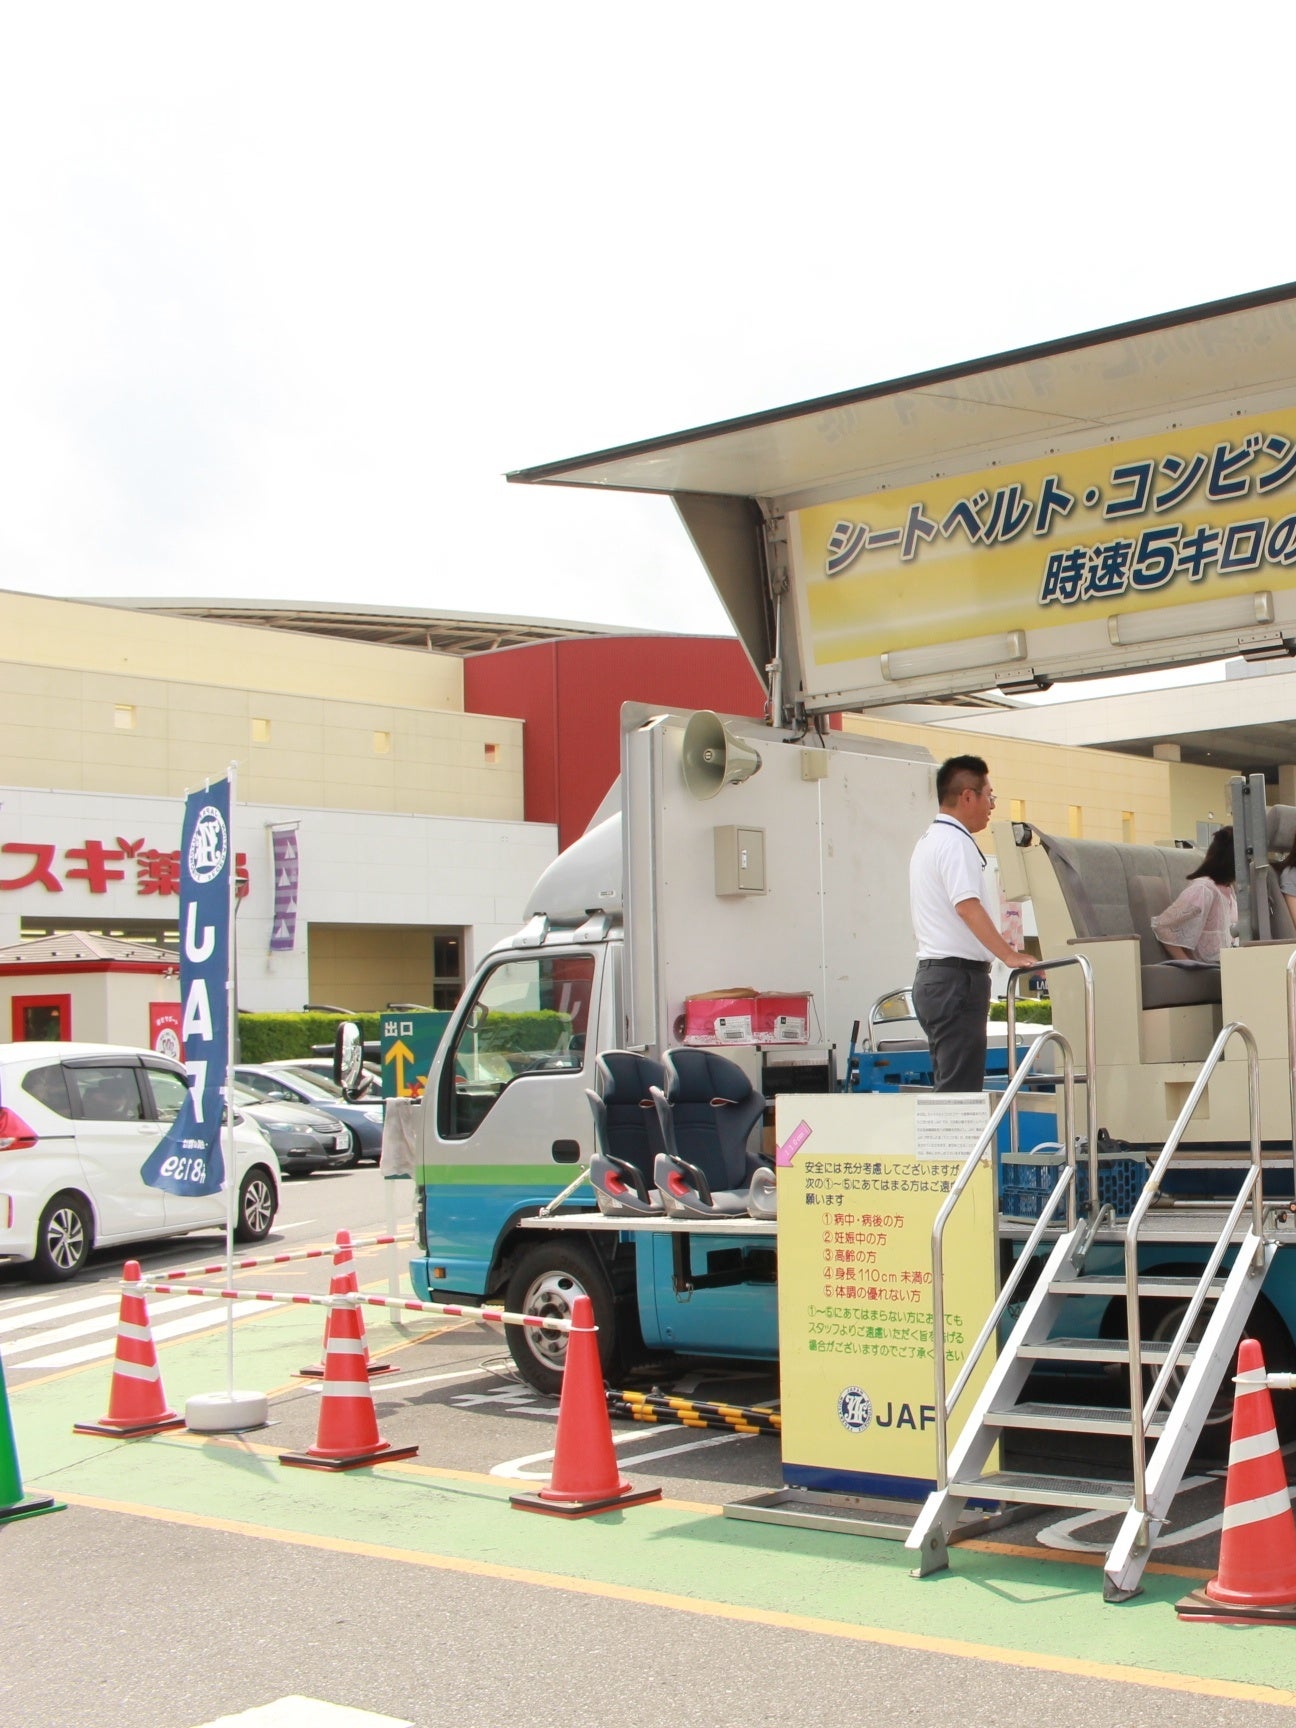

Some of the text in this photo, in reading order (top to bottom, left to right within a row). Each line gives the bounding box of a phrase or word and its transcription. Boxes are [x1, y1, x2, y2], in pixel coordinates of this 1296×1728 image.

[384, 1021, 413, 1037] 出口
[806, 1192, 844, 1207] 願います
[808, 1305, 964, 1327] ①〜⑤にあてはまらない方におても
[808, 1322, 965, 1344] スタッフよりご遠慮いただく旨をげる
[808, 1339, 965, 1362] 場合がございますのでご了承くさい
[876, 1401, 936, 1431] JAF
